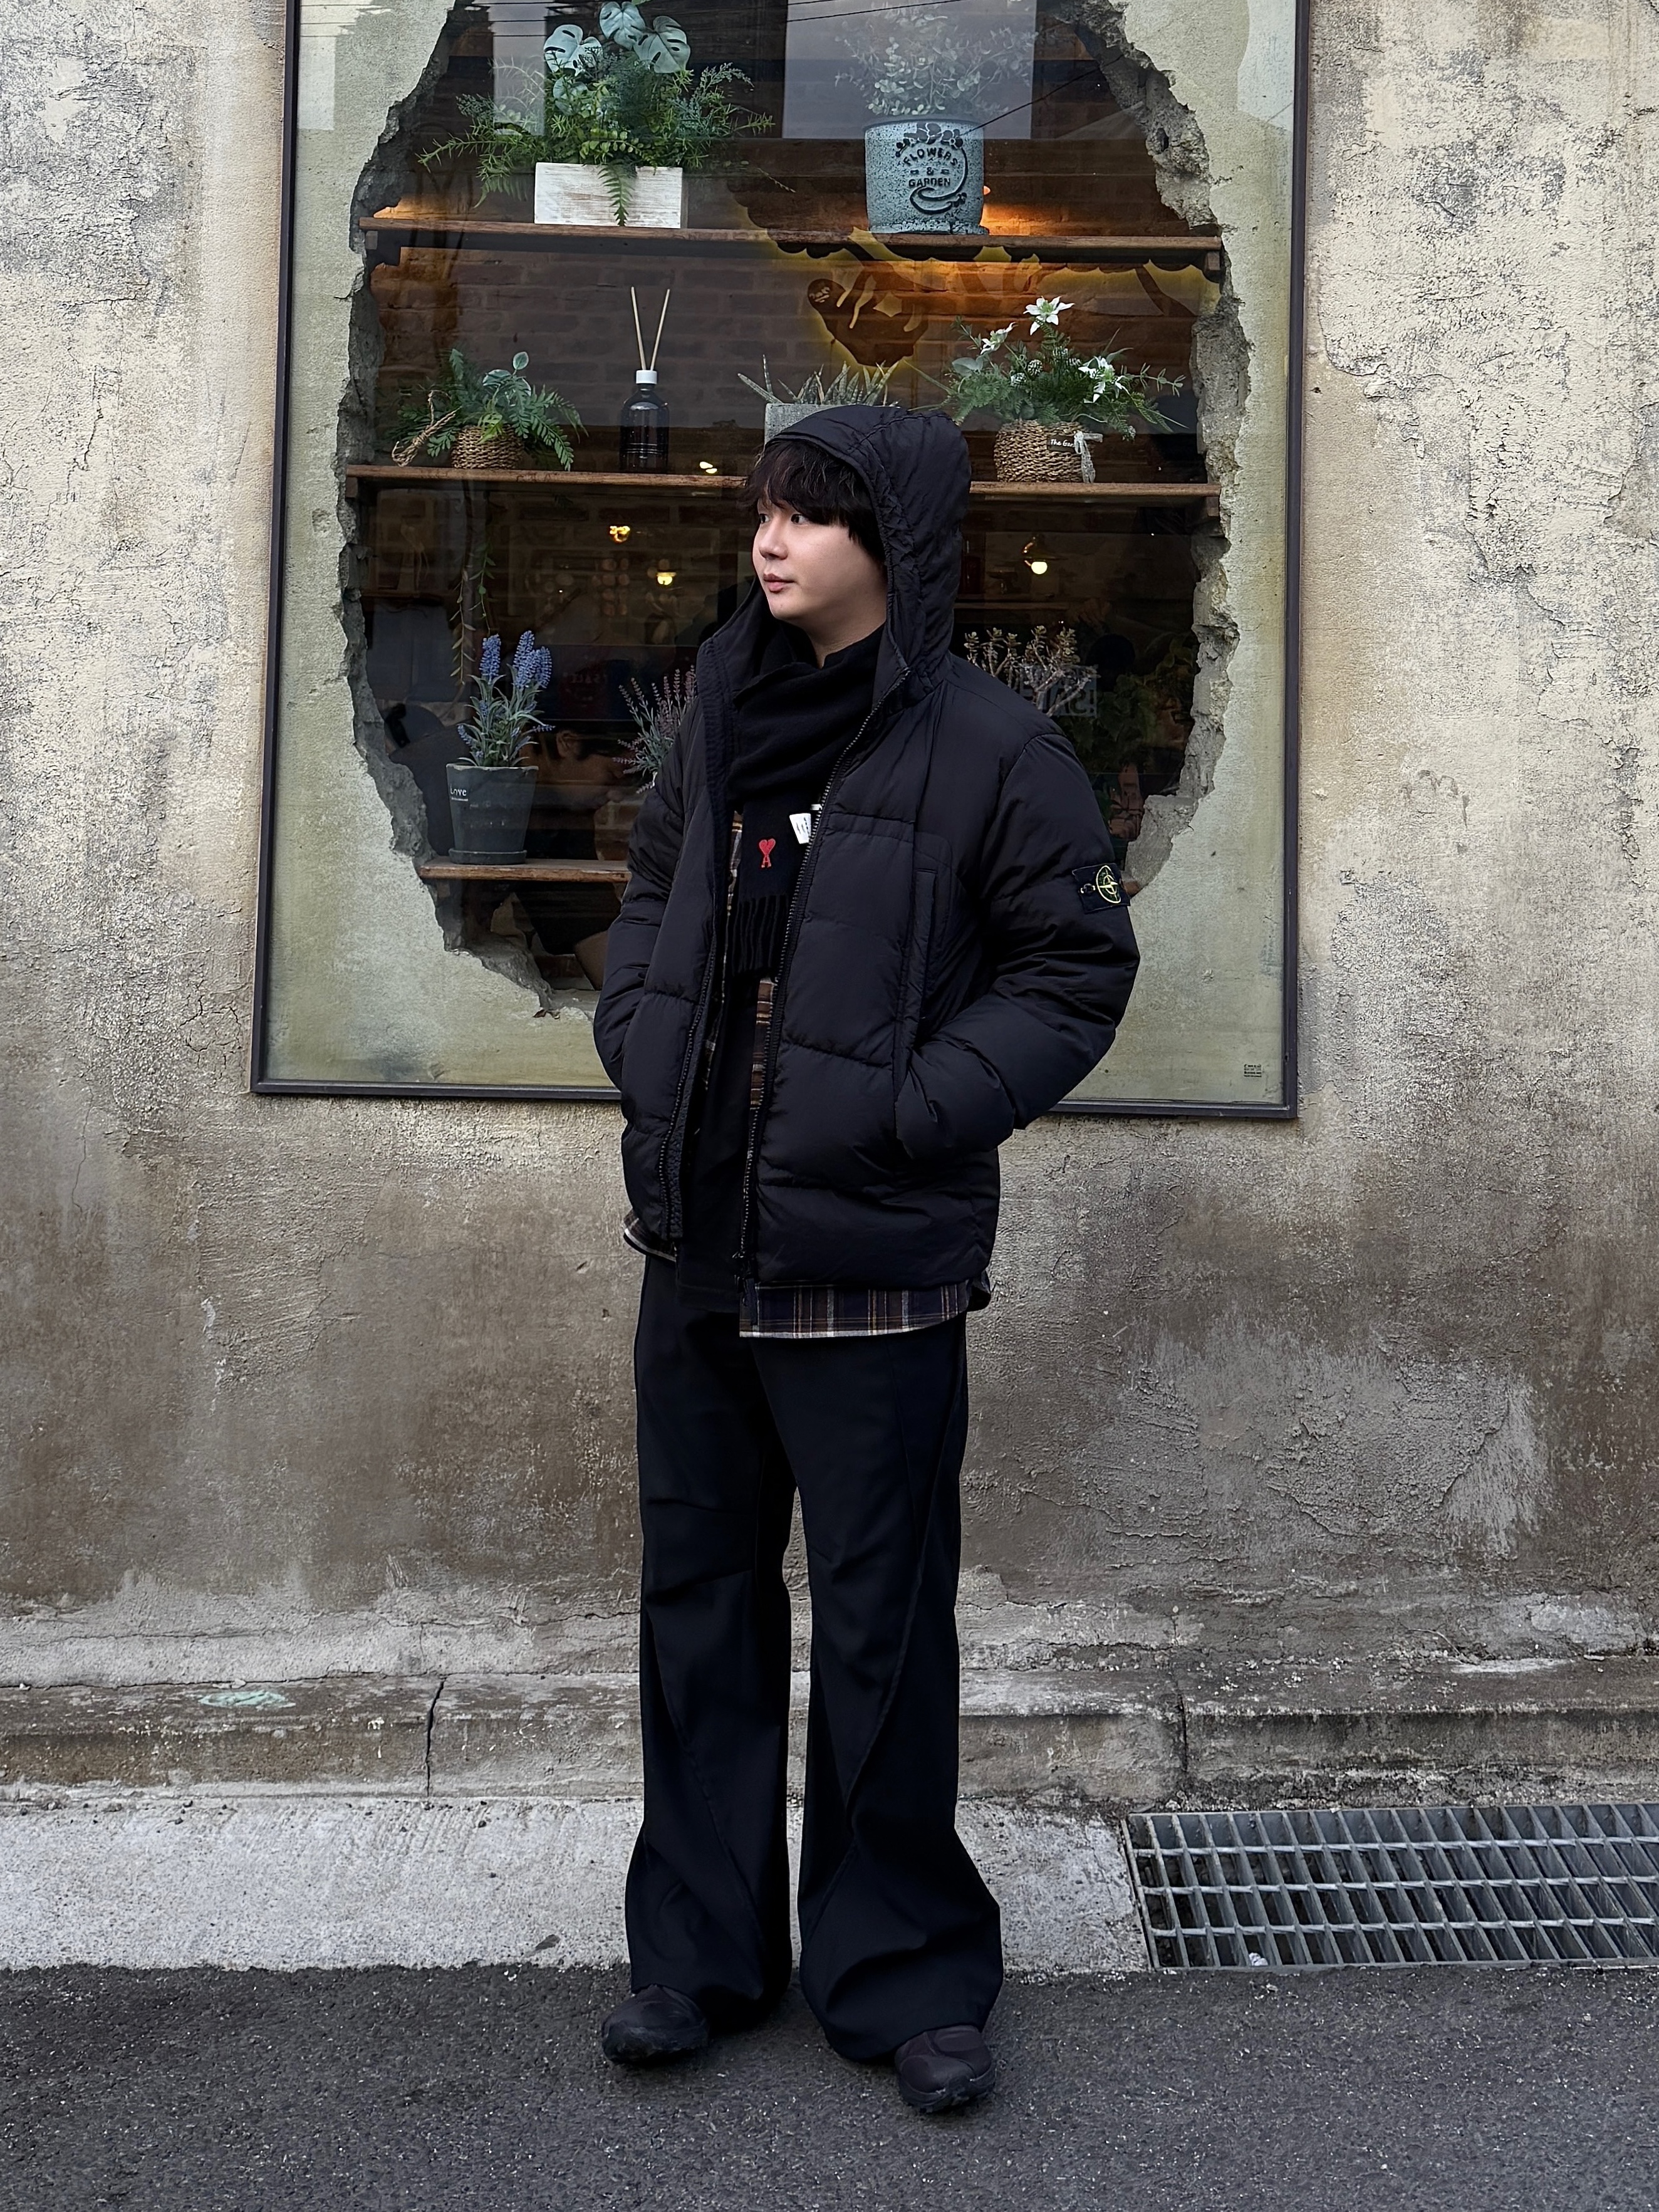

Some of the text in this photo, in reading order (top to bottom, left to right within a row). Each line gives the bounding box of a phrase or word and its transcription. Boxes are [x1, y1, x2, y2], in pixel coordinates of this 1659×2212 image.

[903, 147, 958, 167] FLOWERS
[927, 167, 934, 175] &
[908, 178, 951, 187] GARDEN
[450, 783, 467, 796] Love
